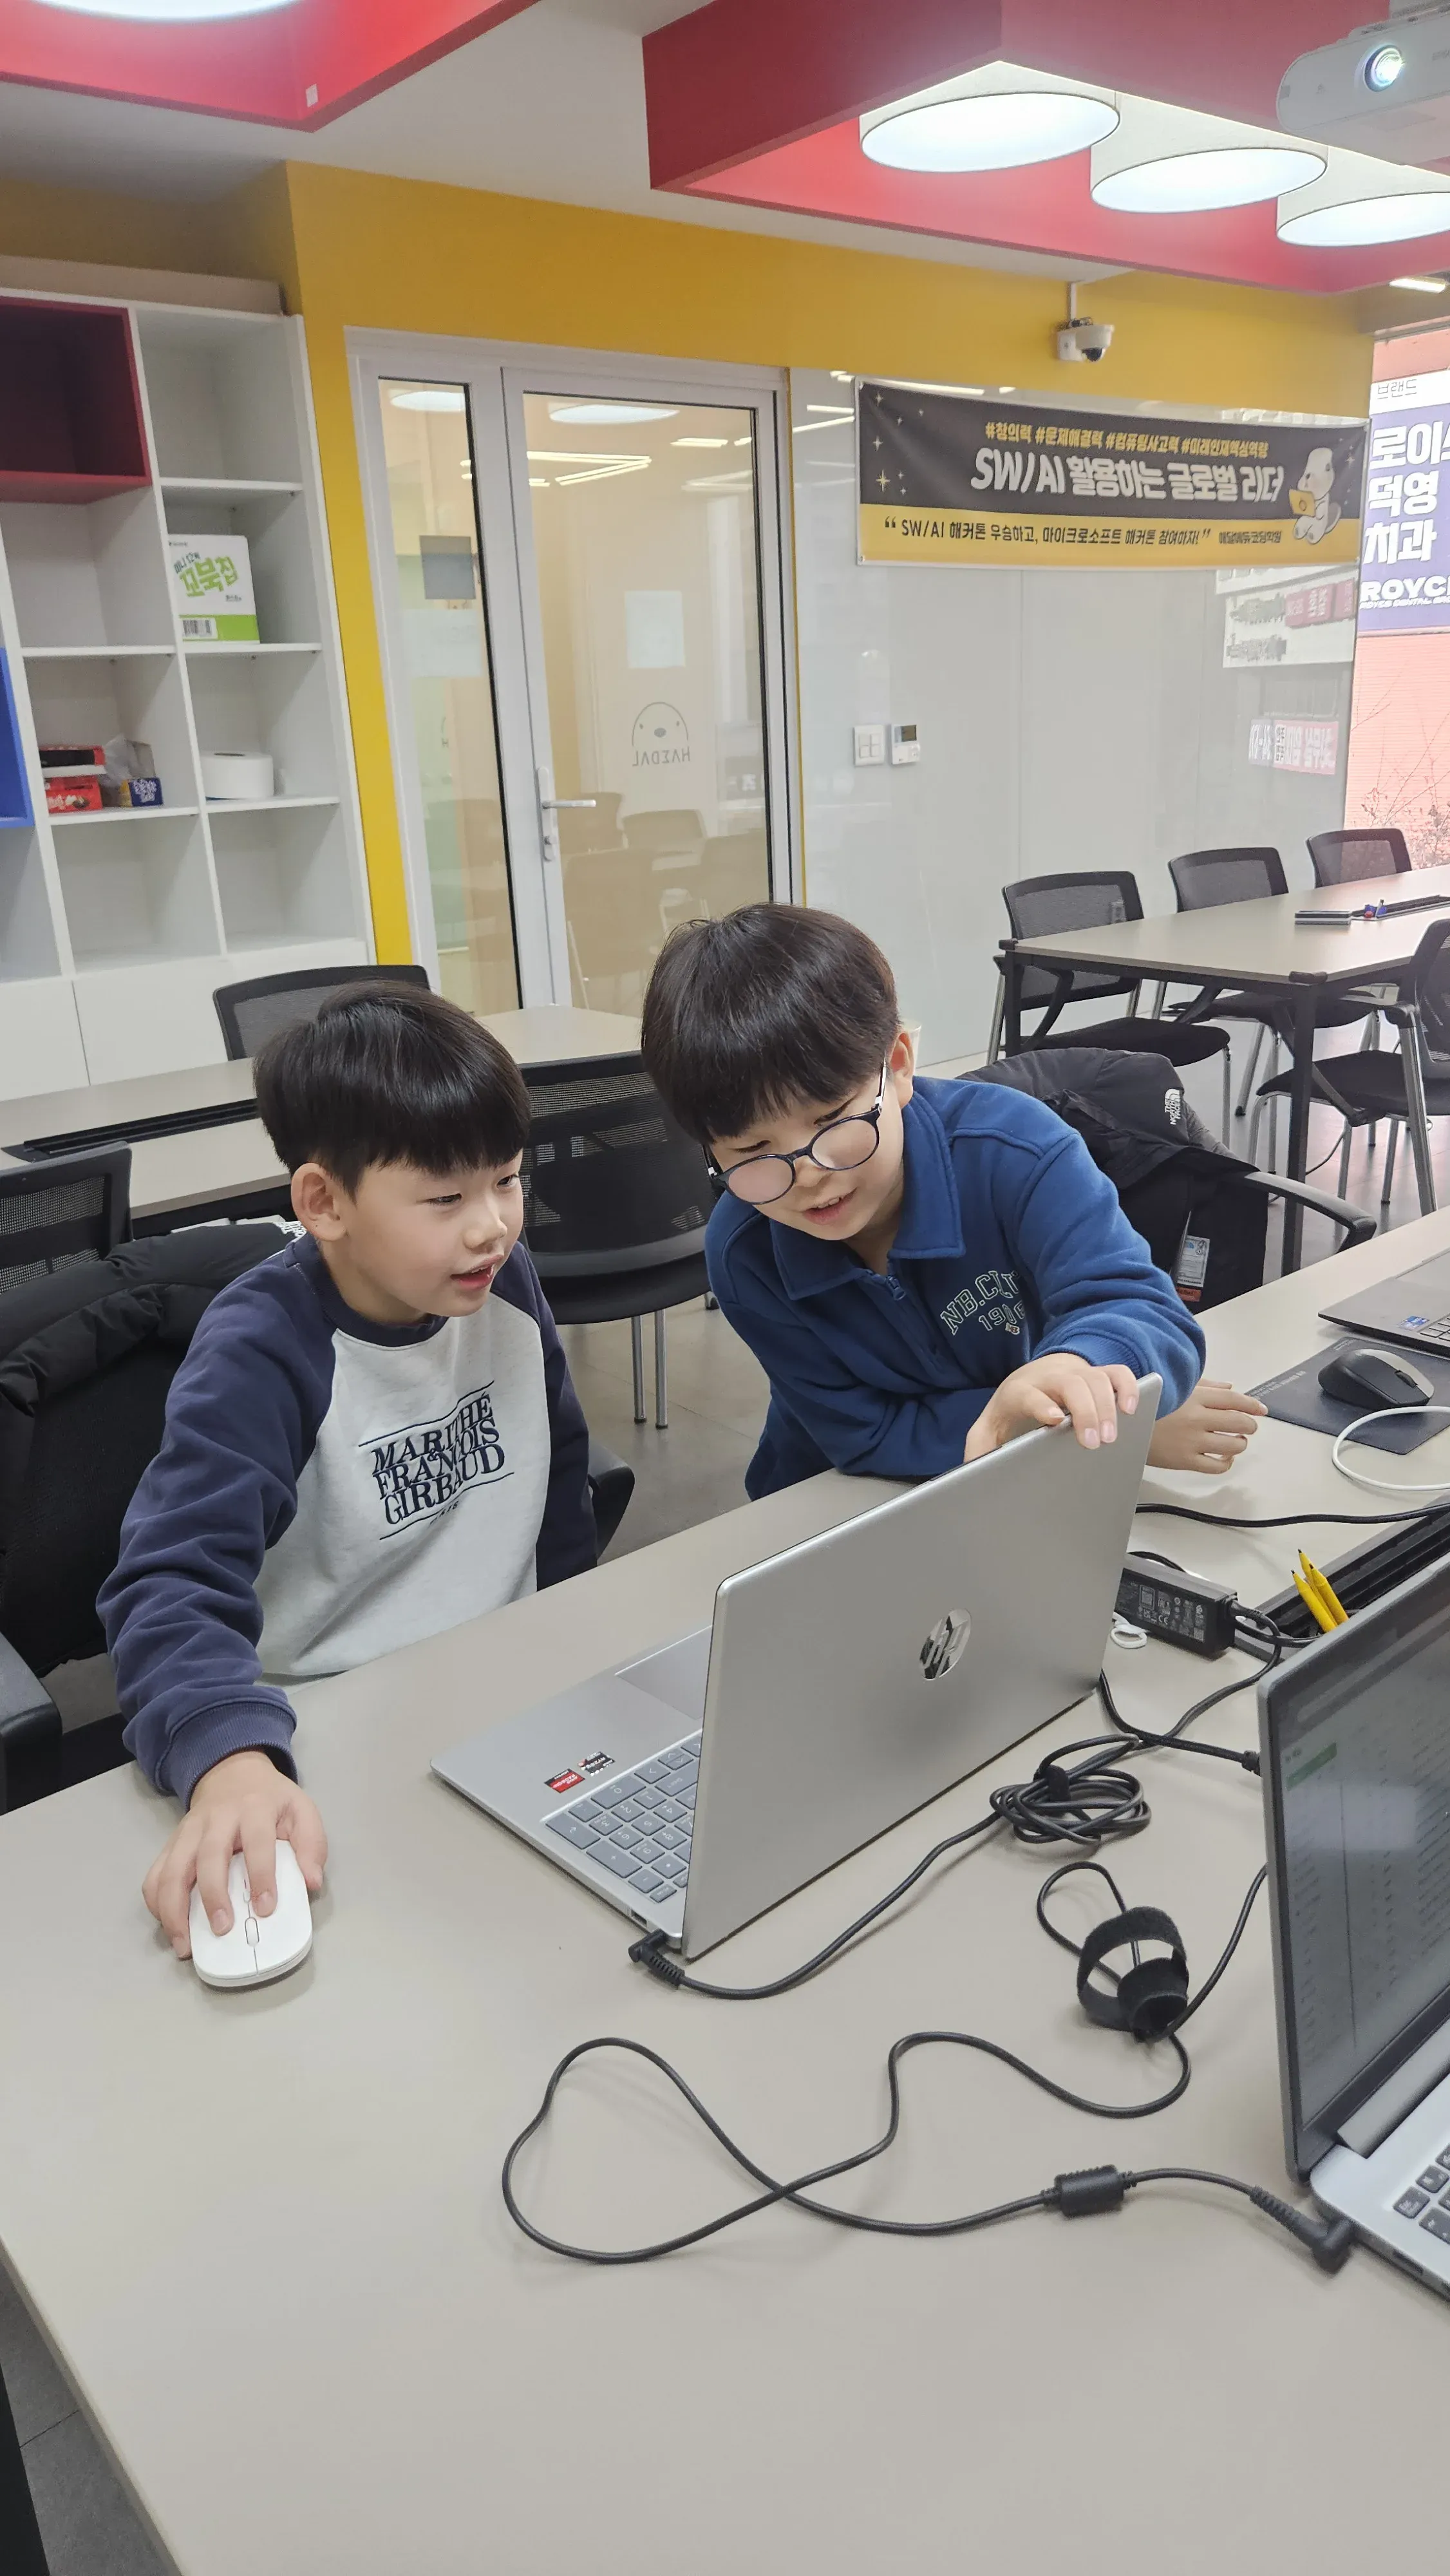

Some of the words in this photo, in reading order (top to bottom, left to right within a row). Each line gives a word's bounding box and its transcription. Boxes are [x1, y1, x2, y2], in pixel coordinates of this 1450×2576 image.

[1377, 379, 1417, 400] 브랜드
[985, 422, 1032, 444] #창의력
[1035, 426, 1104, 449] #문제해결력
[1106, 432, 1180, 454] #컴퓨팅사고력
[1066, 455, 1167, 500] 활용하는
[1167, 462, 1238, 502] 글로벌
[1239, 465, 1284, 503] 리더
[1368, 470, 1439, 516] 덕영
[950, 522, 986, 540] 해커톤
[990, 524, 1038, 544] 우승하고,
[1042, 527, 1122, 544] 마이크로소프트
[1125, 529, 1156, 545] 해커톤
[1362, 519, 1437, 565] 치과
[179, 554, 239, 597] 꼬북칩
[1359, 574, 1450, 602] ROYC
[384, 1443, 505, 1524] GIRBAUD
